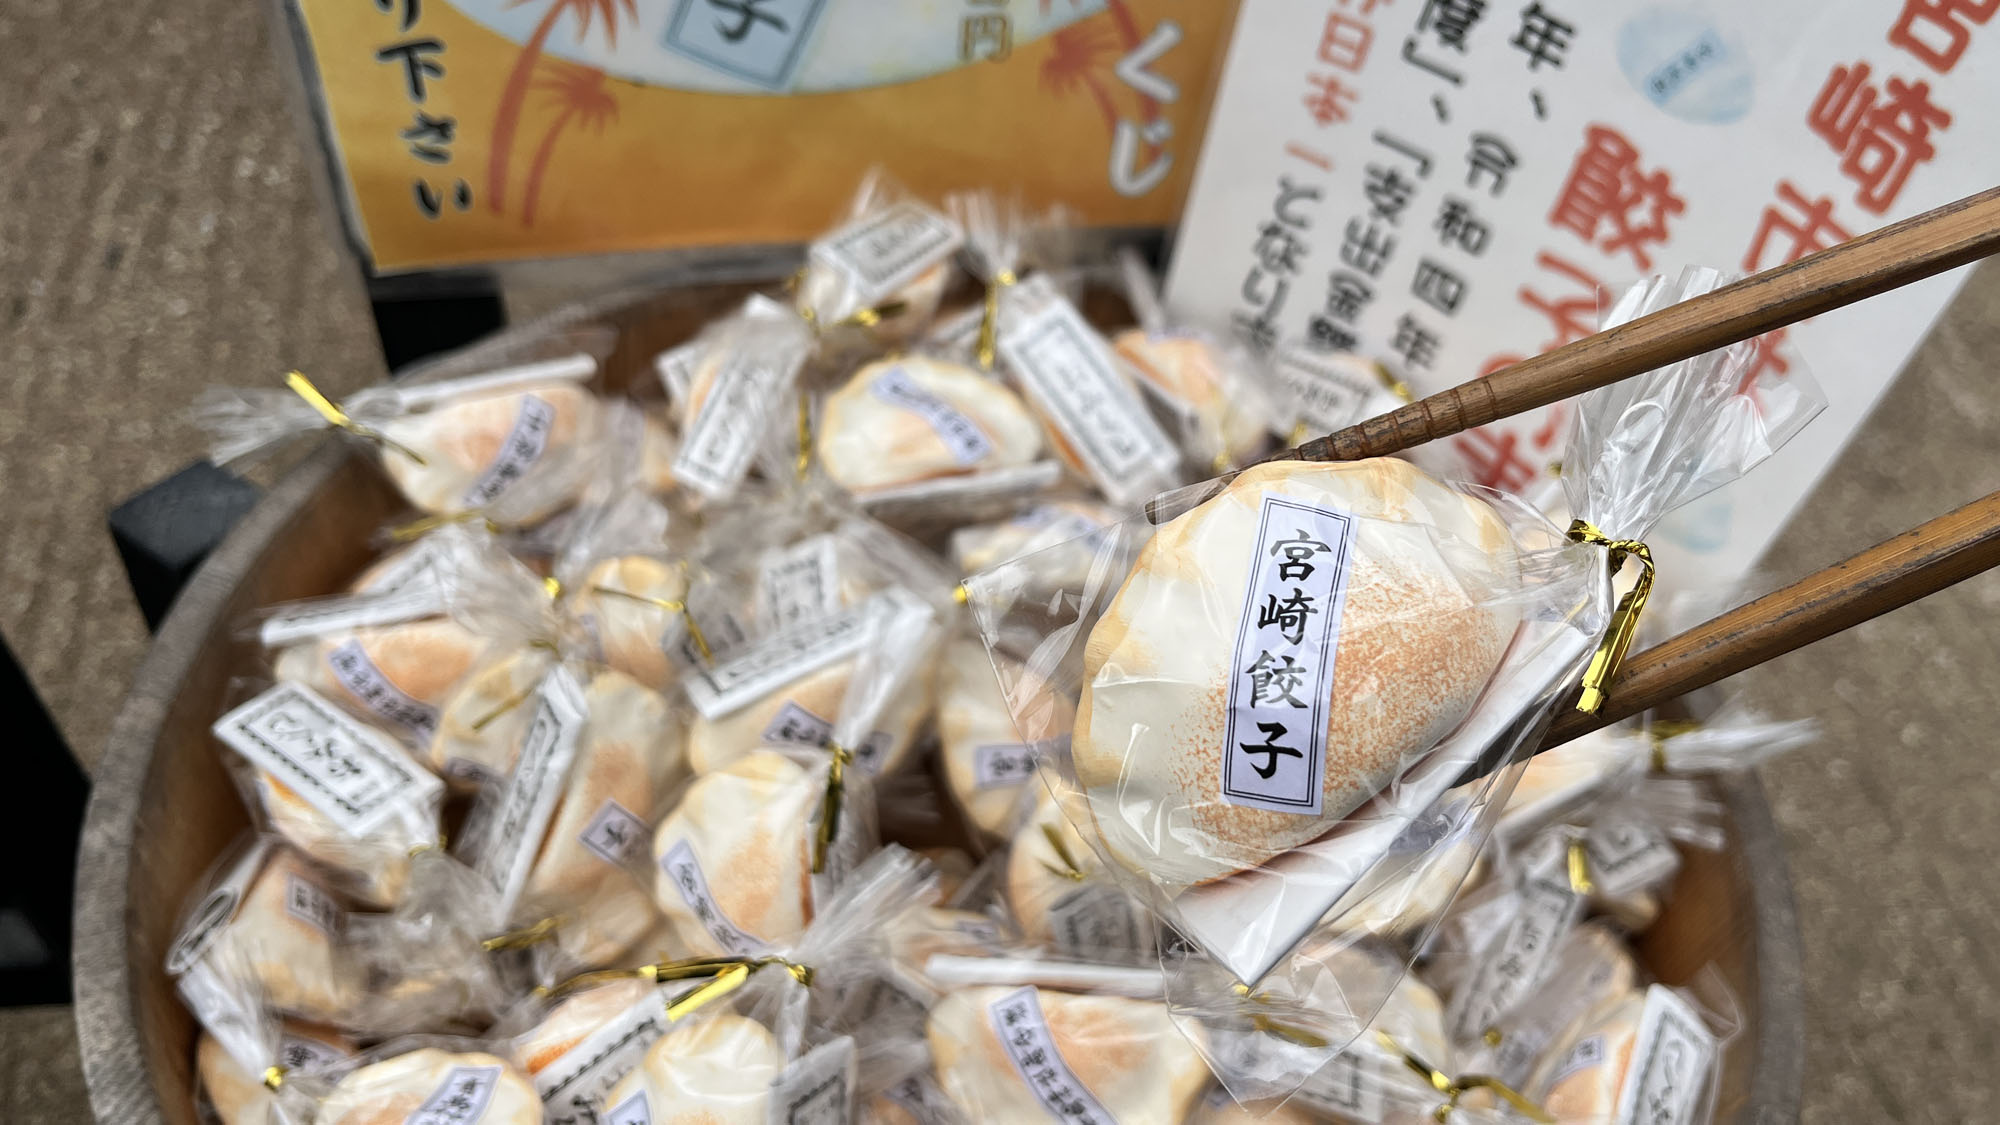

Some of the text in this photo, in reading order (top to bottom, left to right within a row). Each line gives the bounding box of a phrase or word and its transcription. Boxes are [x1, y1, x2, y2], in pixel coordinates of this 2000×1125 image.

[958, 0, 1013, 63] 円
[1109, 19, 1184, 197] くじ
[1389, 2, 1576, 372] 年、令和四年
[1238, 528, 1333, 780] 宮崎餃子
